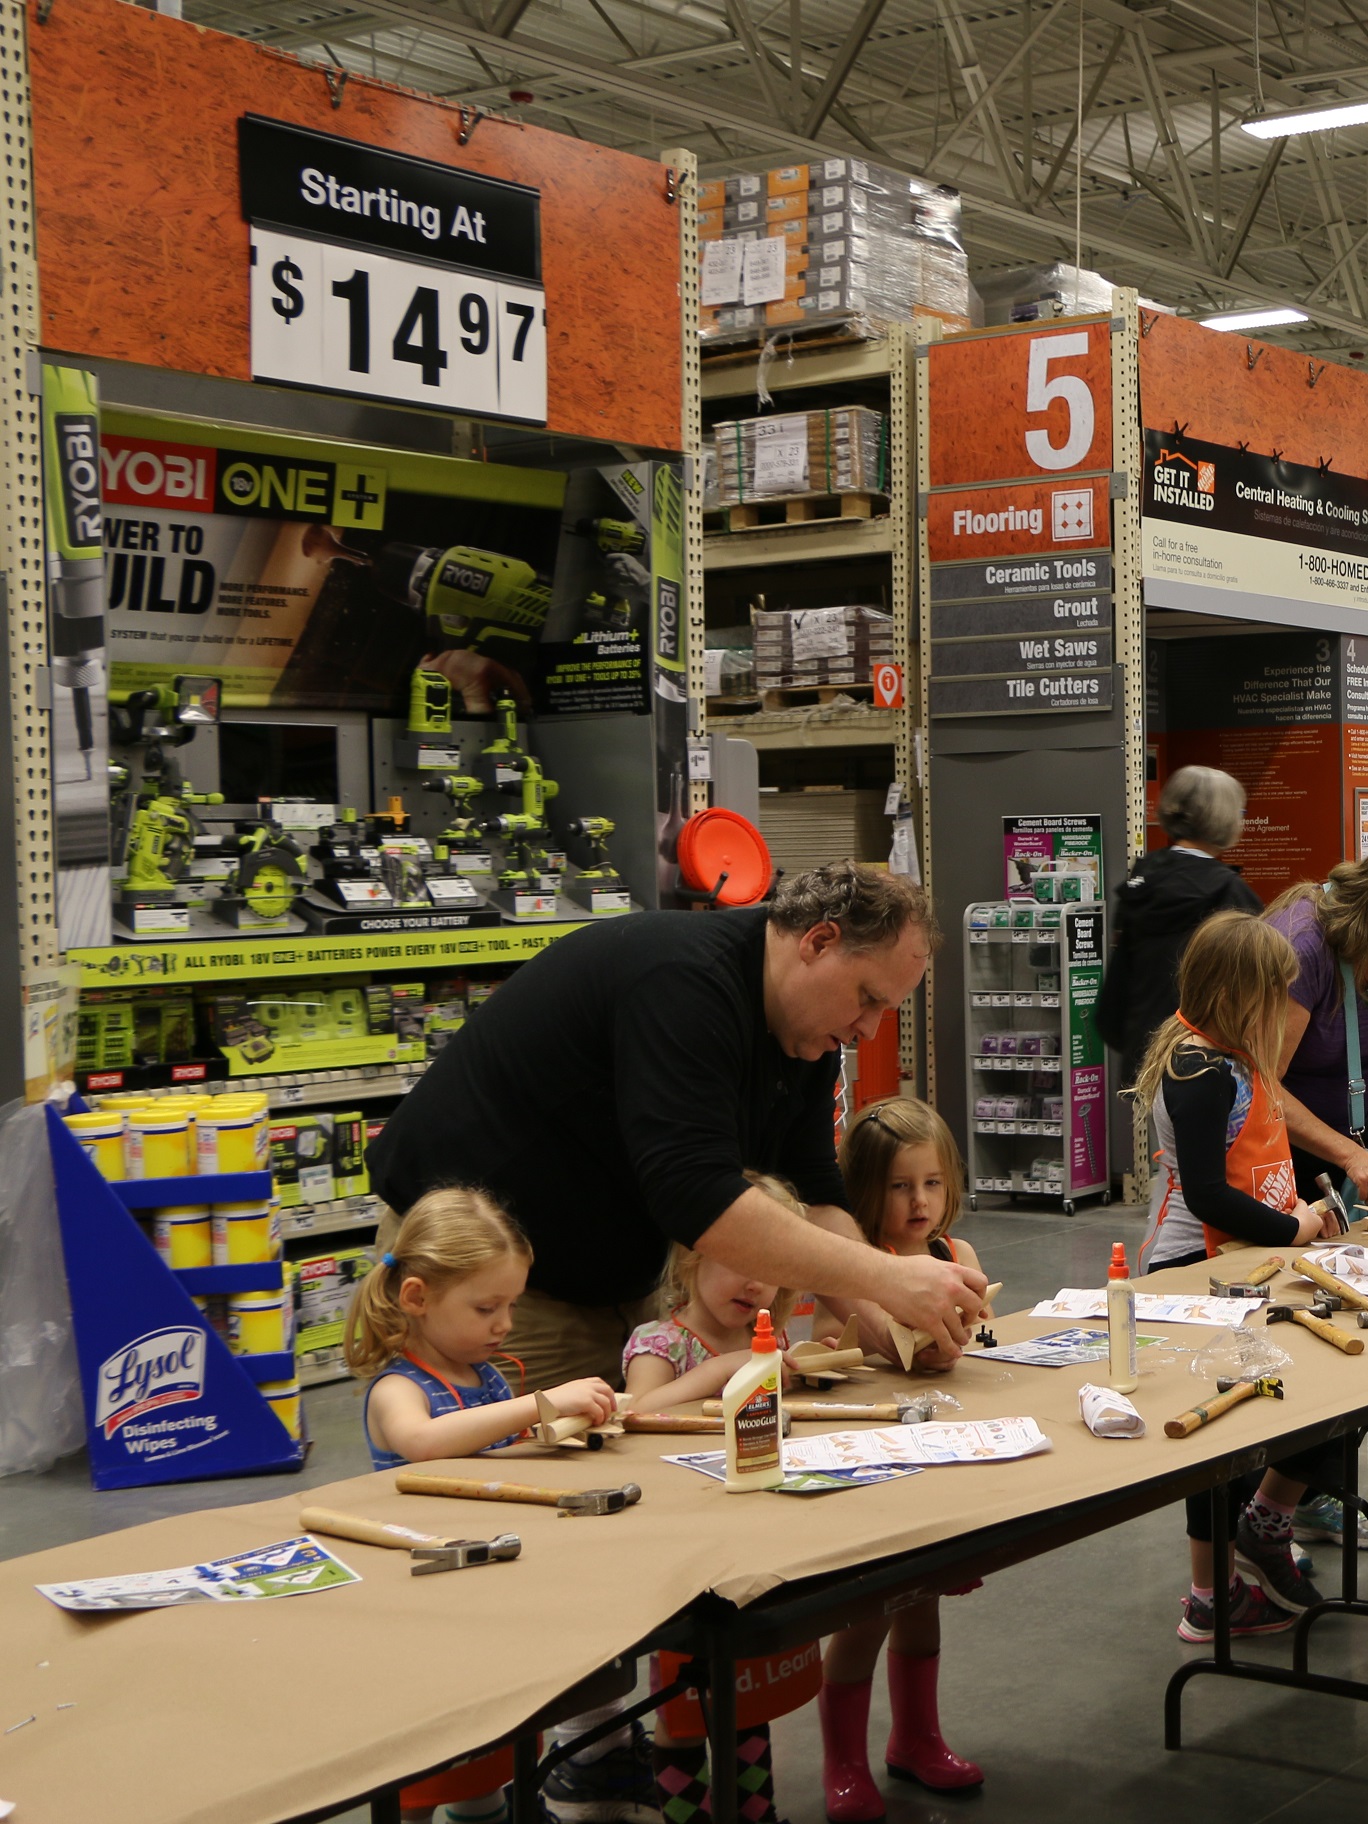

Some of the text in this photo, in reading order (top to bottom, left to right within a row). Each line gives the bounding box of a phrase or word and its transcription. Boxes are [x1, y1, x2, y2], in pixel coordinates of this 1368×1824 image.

[301, 168, 486, 243] Starting At
[1025, 331, 1094, 470] 5
[64, 424, 102, 541] RYOBI
[100, 446, 209, 500] YOBI
[1154, 465, 1190, 489] GET IT
[1153, 483, 1215, 512] INSTALLED
[1235, 481, 1275, 506] Central
[1276, 490, 1315, 518] Heating
[1316, 499, 1324, 515] &
[1325, 501, 1360, 526] Cooling
[953, 506, 1043, 536] Flooring
[1254, 509, 1283, 525] Sistemas
[1283, 515, 1292, 527] de
[103, 516, 204, 555] WER TO
[1153, 535, 1198, 553] Call for a free
[1153, 549, 1223, 571] in-home consultation
[104, 551, 216, 615] UILD
[444, 563, 490, 593] RYOBI
[985, 559, 1096, 585] Ceramic Tools
[1349, 582, 1360, 592] and
[1053, 597, 1098, 617] Grout
[659, 583, 677, 655] RYOBI
[1019, 639, 1097, 659] Wet Saws
[1315, 638, 1331, 662] 3
[1346, 638, 1356, 662] 4
[1264, 663, 1331, 678] Experience the
[1006, 678, 1099, 697] Tile Cutters
[1243, 676, 1332, 690] Difference That Our
[1346, 676, 1363, 688] FREE
[1233, 690, 1332, 703] HVAC Specialist Make
[1018, 817, 1087, 827] Cement Board Screws
[1257, 825, 1290, 834] Agreement
[360, 915, 470, 931] CHOOSE YOUR BATTERY
[1074, 917, 1094, 928] Cement
[184, 954, 206, 969] ALL
[250, 951, 270, 965] 18V
[307, 946, 363, 963] BATTERIES
[366, 944, 403, 959] POWER
[405, 943, 436, 957] EVERY
[440, 941, 457, 955] 18V
[487, 938, 511, 951] TOOL
[1075, 939, 1094, 949] Screws
[89, 1075, 122, 1088] RYOBI
[174, 1065, 205, 1079] RYOBI
[1259, 1170, 1277, 1193] THE
[301, 1261, 336, 1278] RYOBI
[104, 1334, 195, 1403] Lysol
[122, 1414, 219, 1439] Disinfecting
[124, 1437, 178, 1455] Wipes
